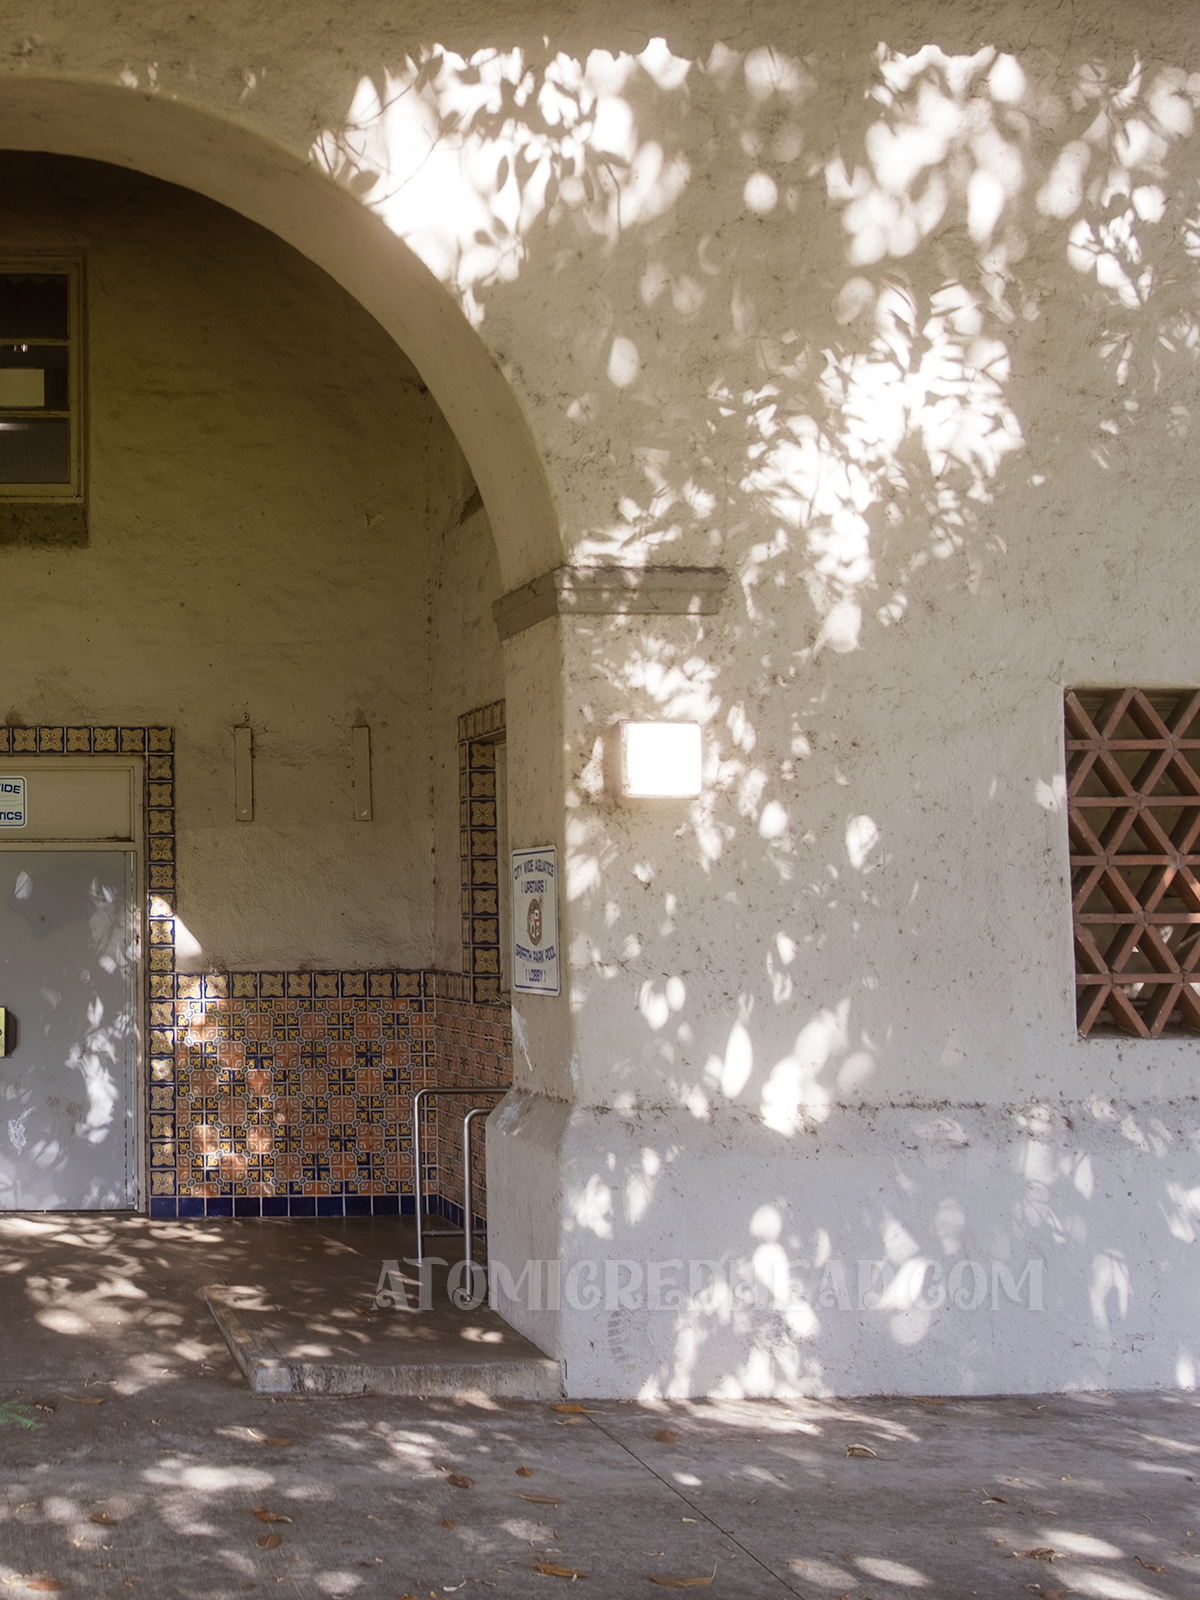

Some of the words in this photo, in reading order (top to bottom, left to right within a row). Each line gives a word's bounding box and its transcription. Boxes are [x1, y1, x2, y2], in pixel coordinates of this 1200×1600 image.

[514, 864, 522, 880] CITY
[523, 859, 533, 874] WIDE
[535, 859, 553, 877] AQUATICS
[516, 943, 532, 963] GRIFFITH
[533, 950, 544, 963] PARK
[545, 945, 555, 962] POOL
